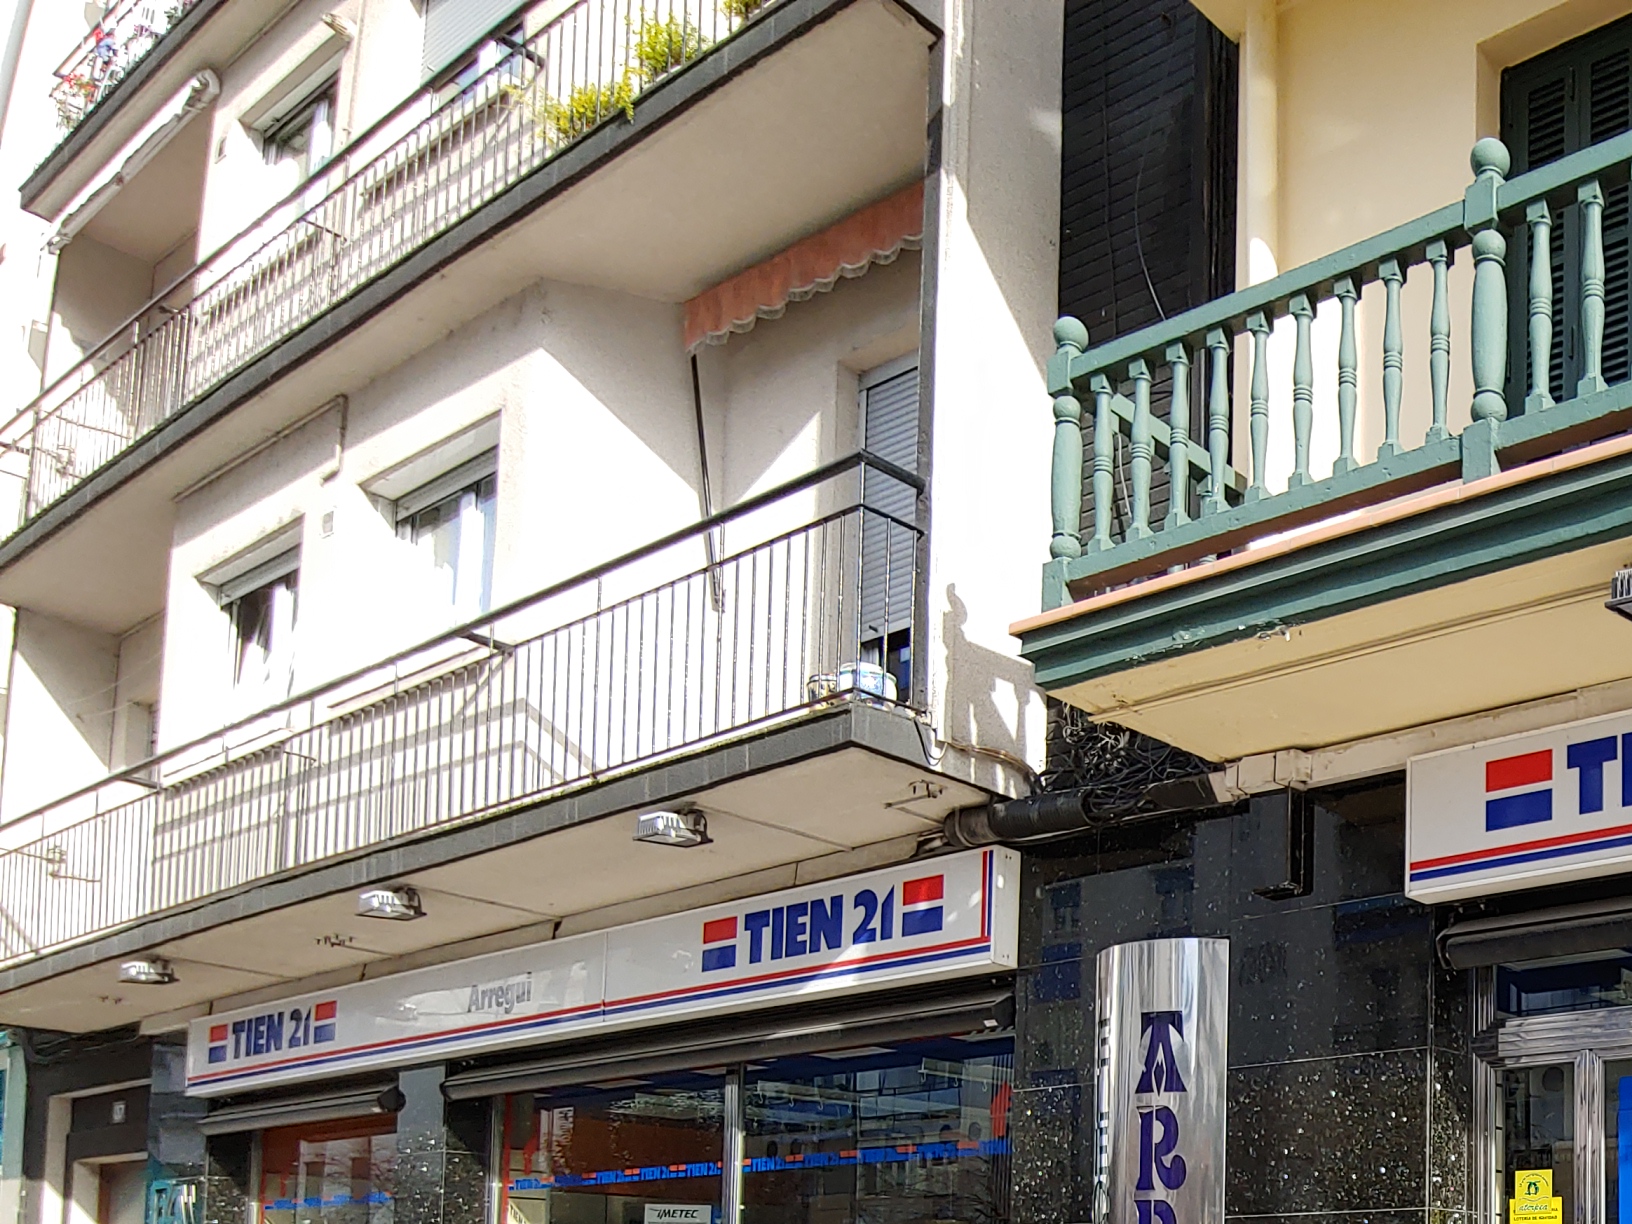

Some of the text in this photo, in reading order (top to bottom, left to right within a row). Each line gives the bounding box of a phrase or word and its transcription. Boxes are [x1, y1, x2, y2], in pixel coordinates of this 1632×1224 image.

[744, 884, 895, 966] TIEN 21
[467, 972, 533, 1014] Arregui
[231, 1007, 312, 1059] TIEN 21
